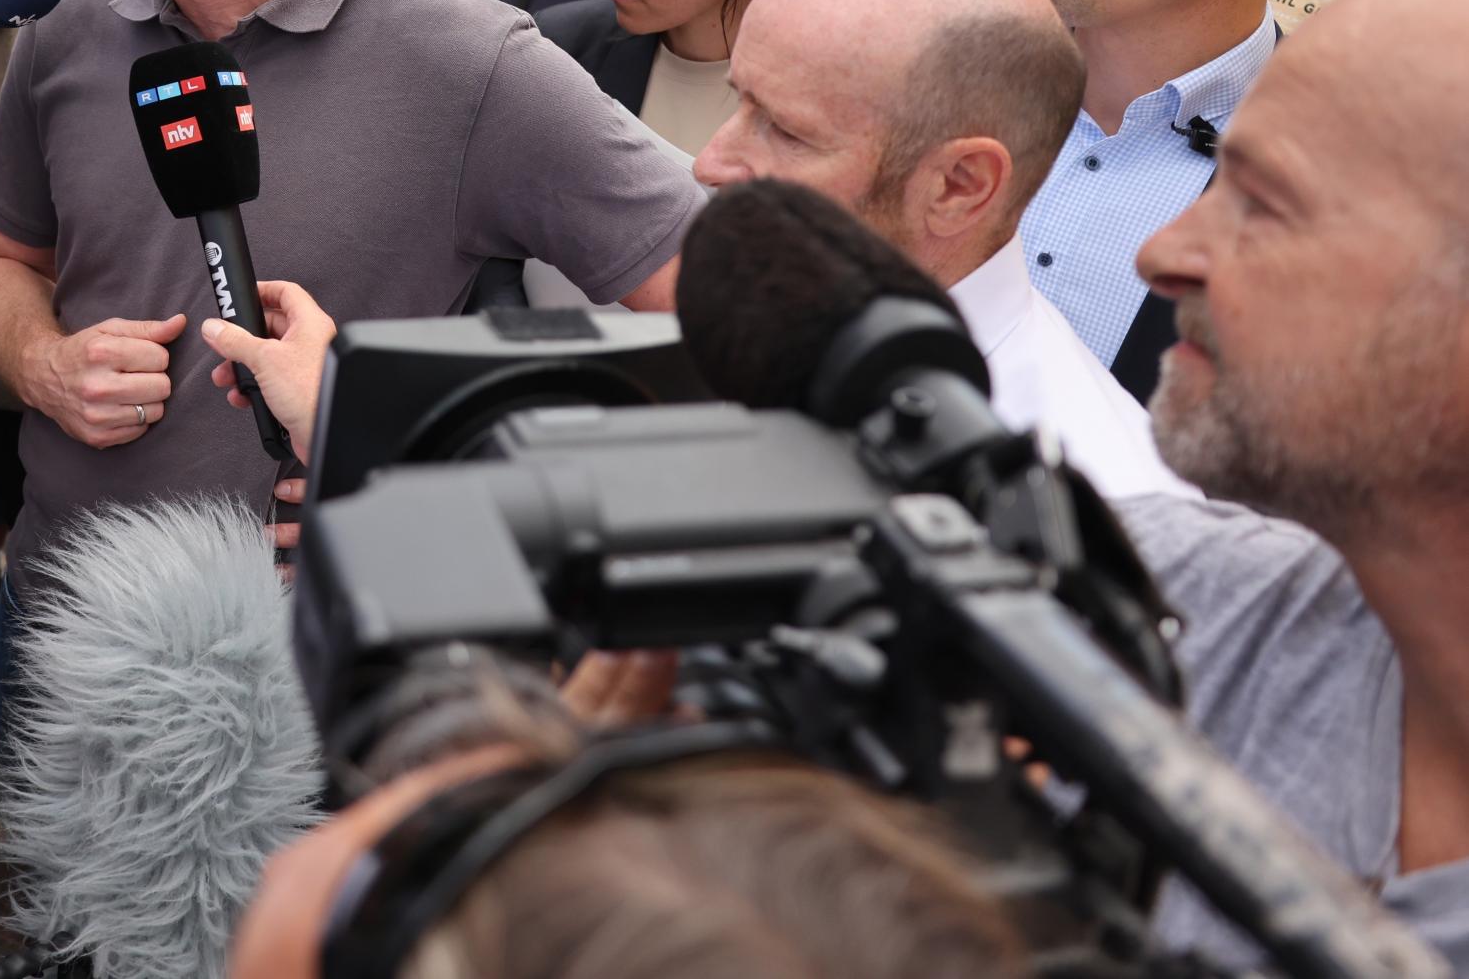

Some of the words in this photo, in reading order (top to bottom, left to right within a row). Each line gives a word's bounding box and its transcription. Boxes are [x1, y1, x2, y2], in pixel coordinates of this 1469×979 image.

[141, 80, 200, 103] RTL
[167, 124, 195, 144] ntv
[212, 266, 237, 319] TVN
